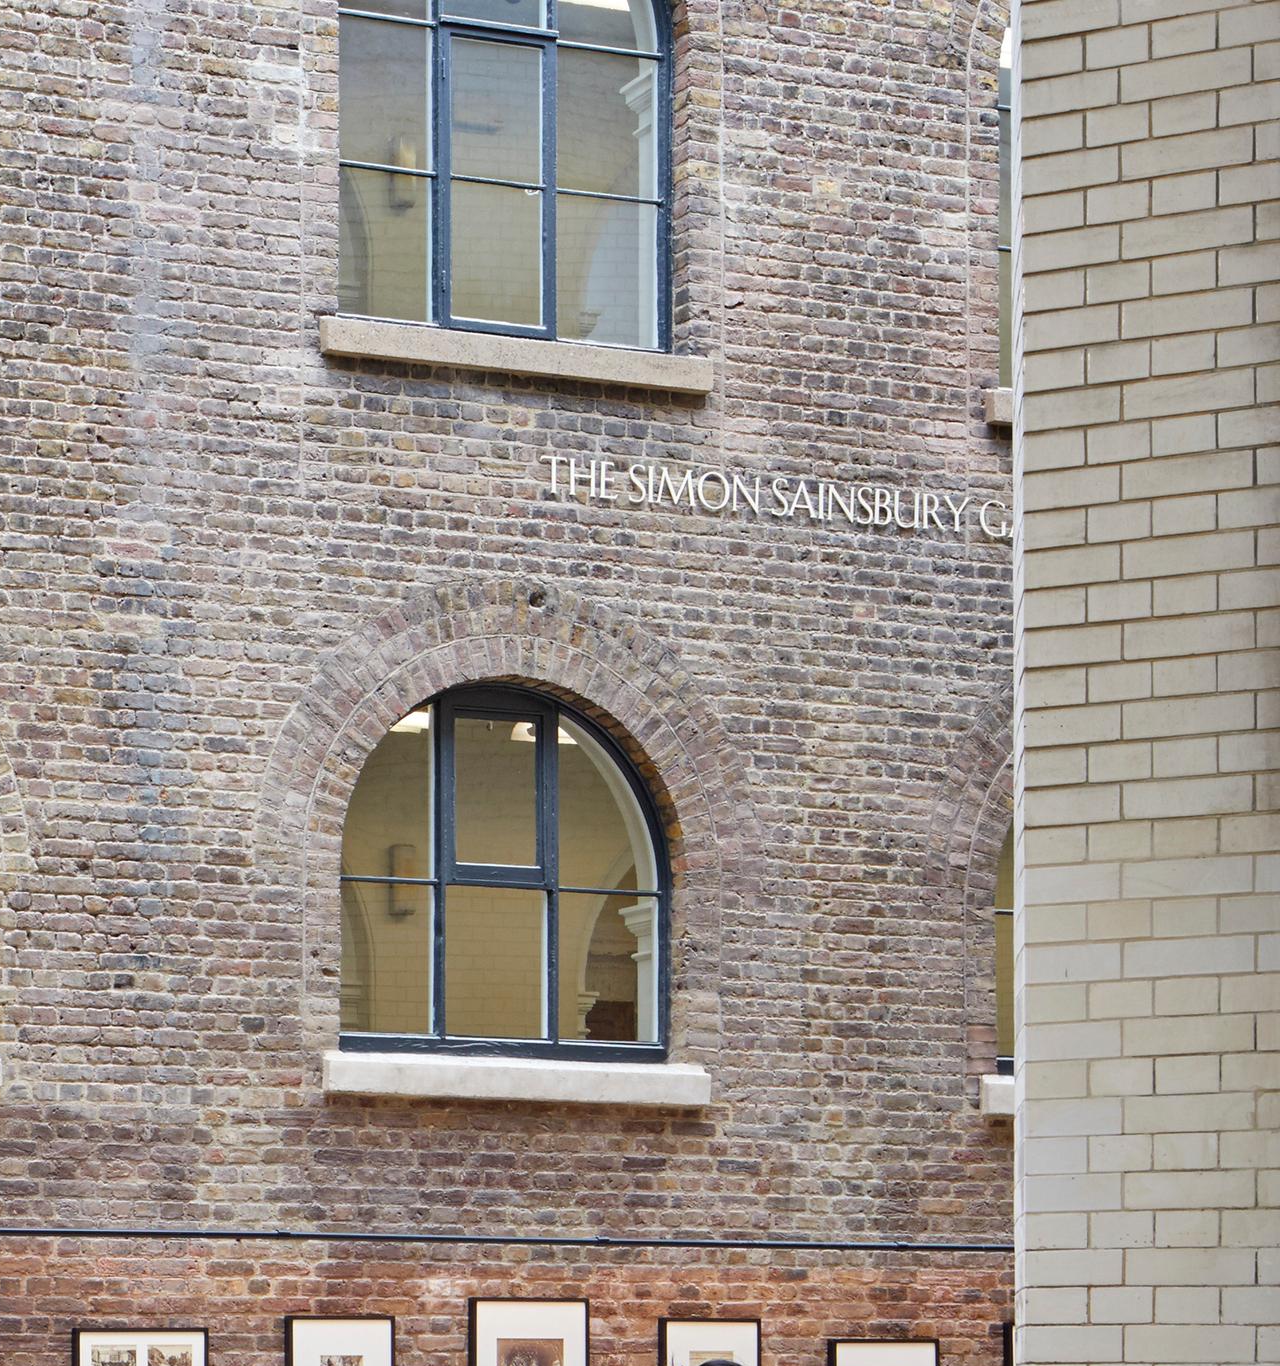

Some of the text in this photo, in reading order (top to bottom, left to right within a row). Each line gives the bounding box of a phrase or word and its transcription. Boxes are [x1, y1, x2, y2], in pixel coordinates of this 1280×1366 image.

[540, 455, 1014, 538] THE SIMON SAINSBURY G
